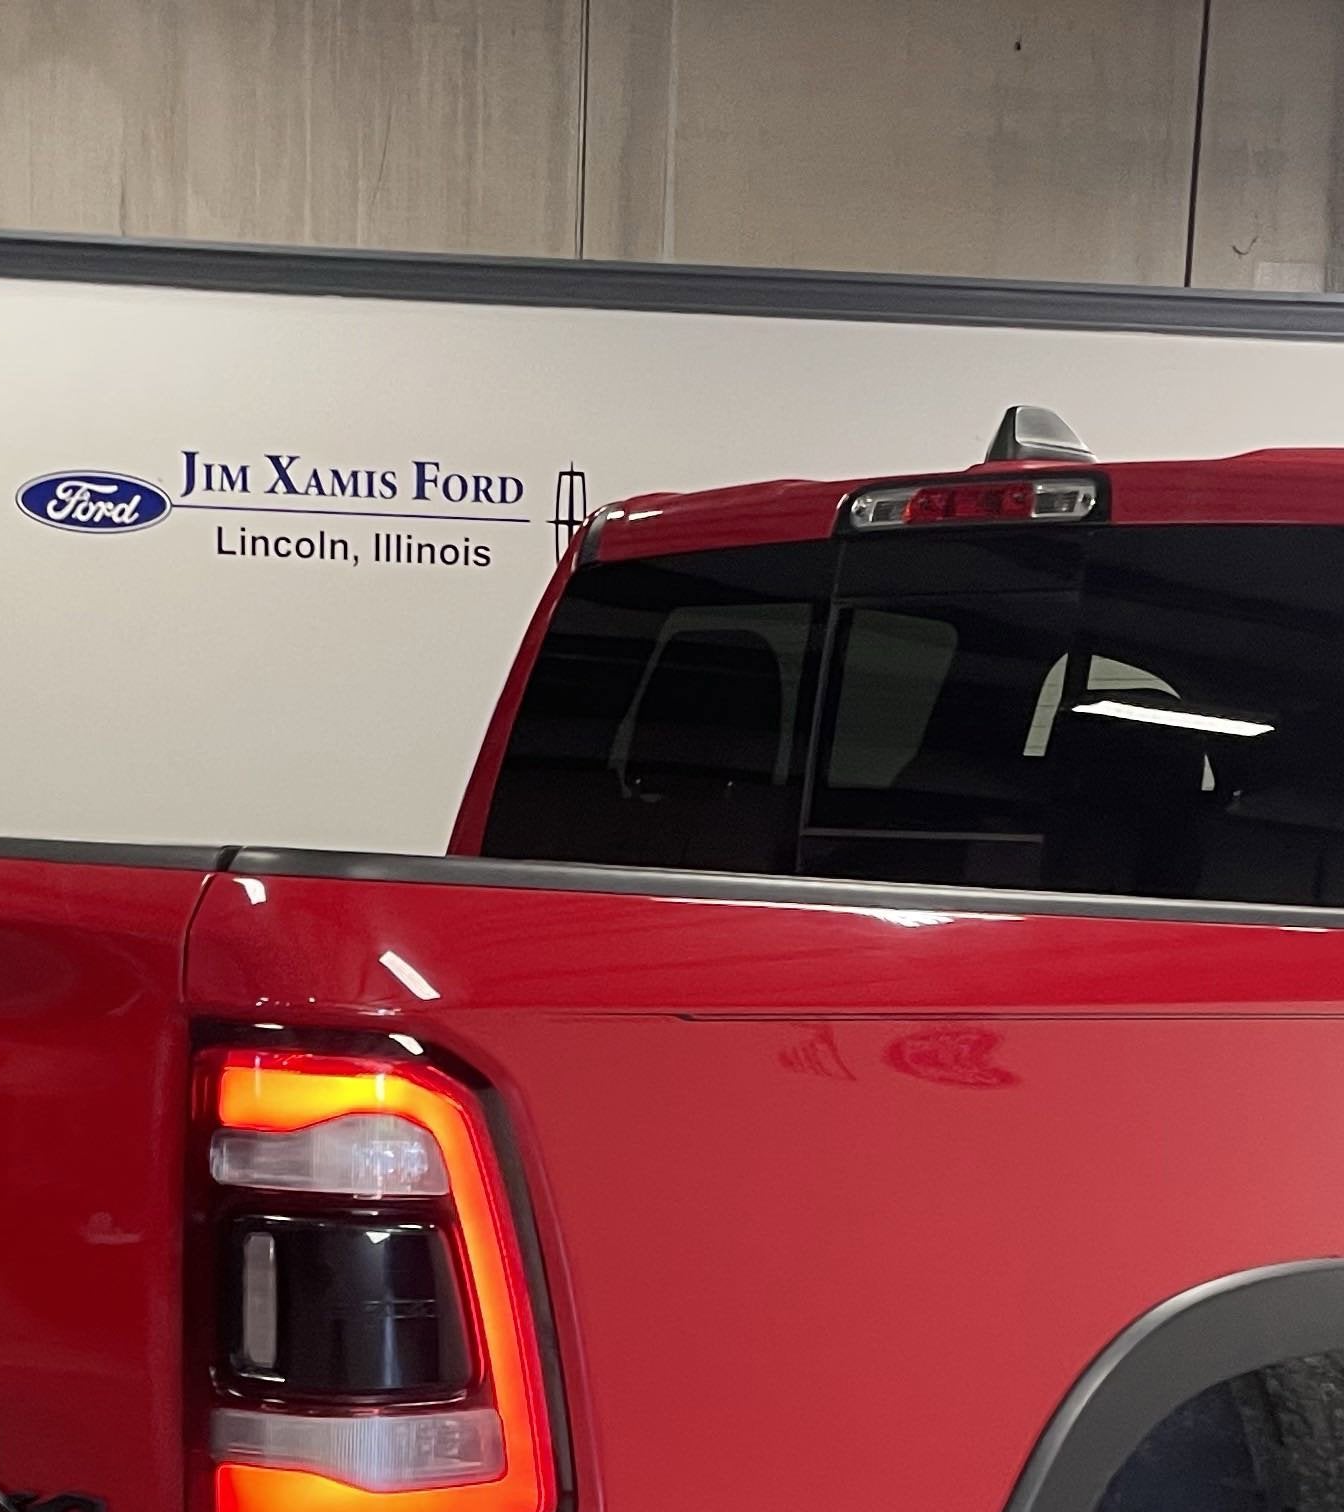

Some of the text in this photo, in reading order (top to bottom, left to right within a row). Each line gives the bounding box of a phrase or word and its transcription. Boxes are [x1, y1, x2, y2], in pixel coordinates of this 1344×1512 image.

[46, 480, 141, 525] Ford
[217, 526, 491, 567] Lincoln, Illinois
